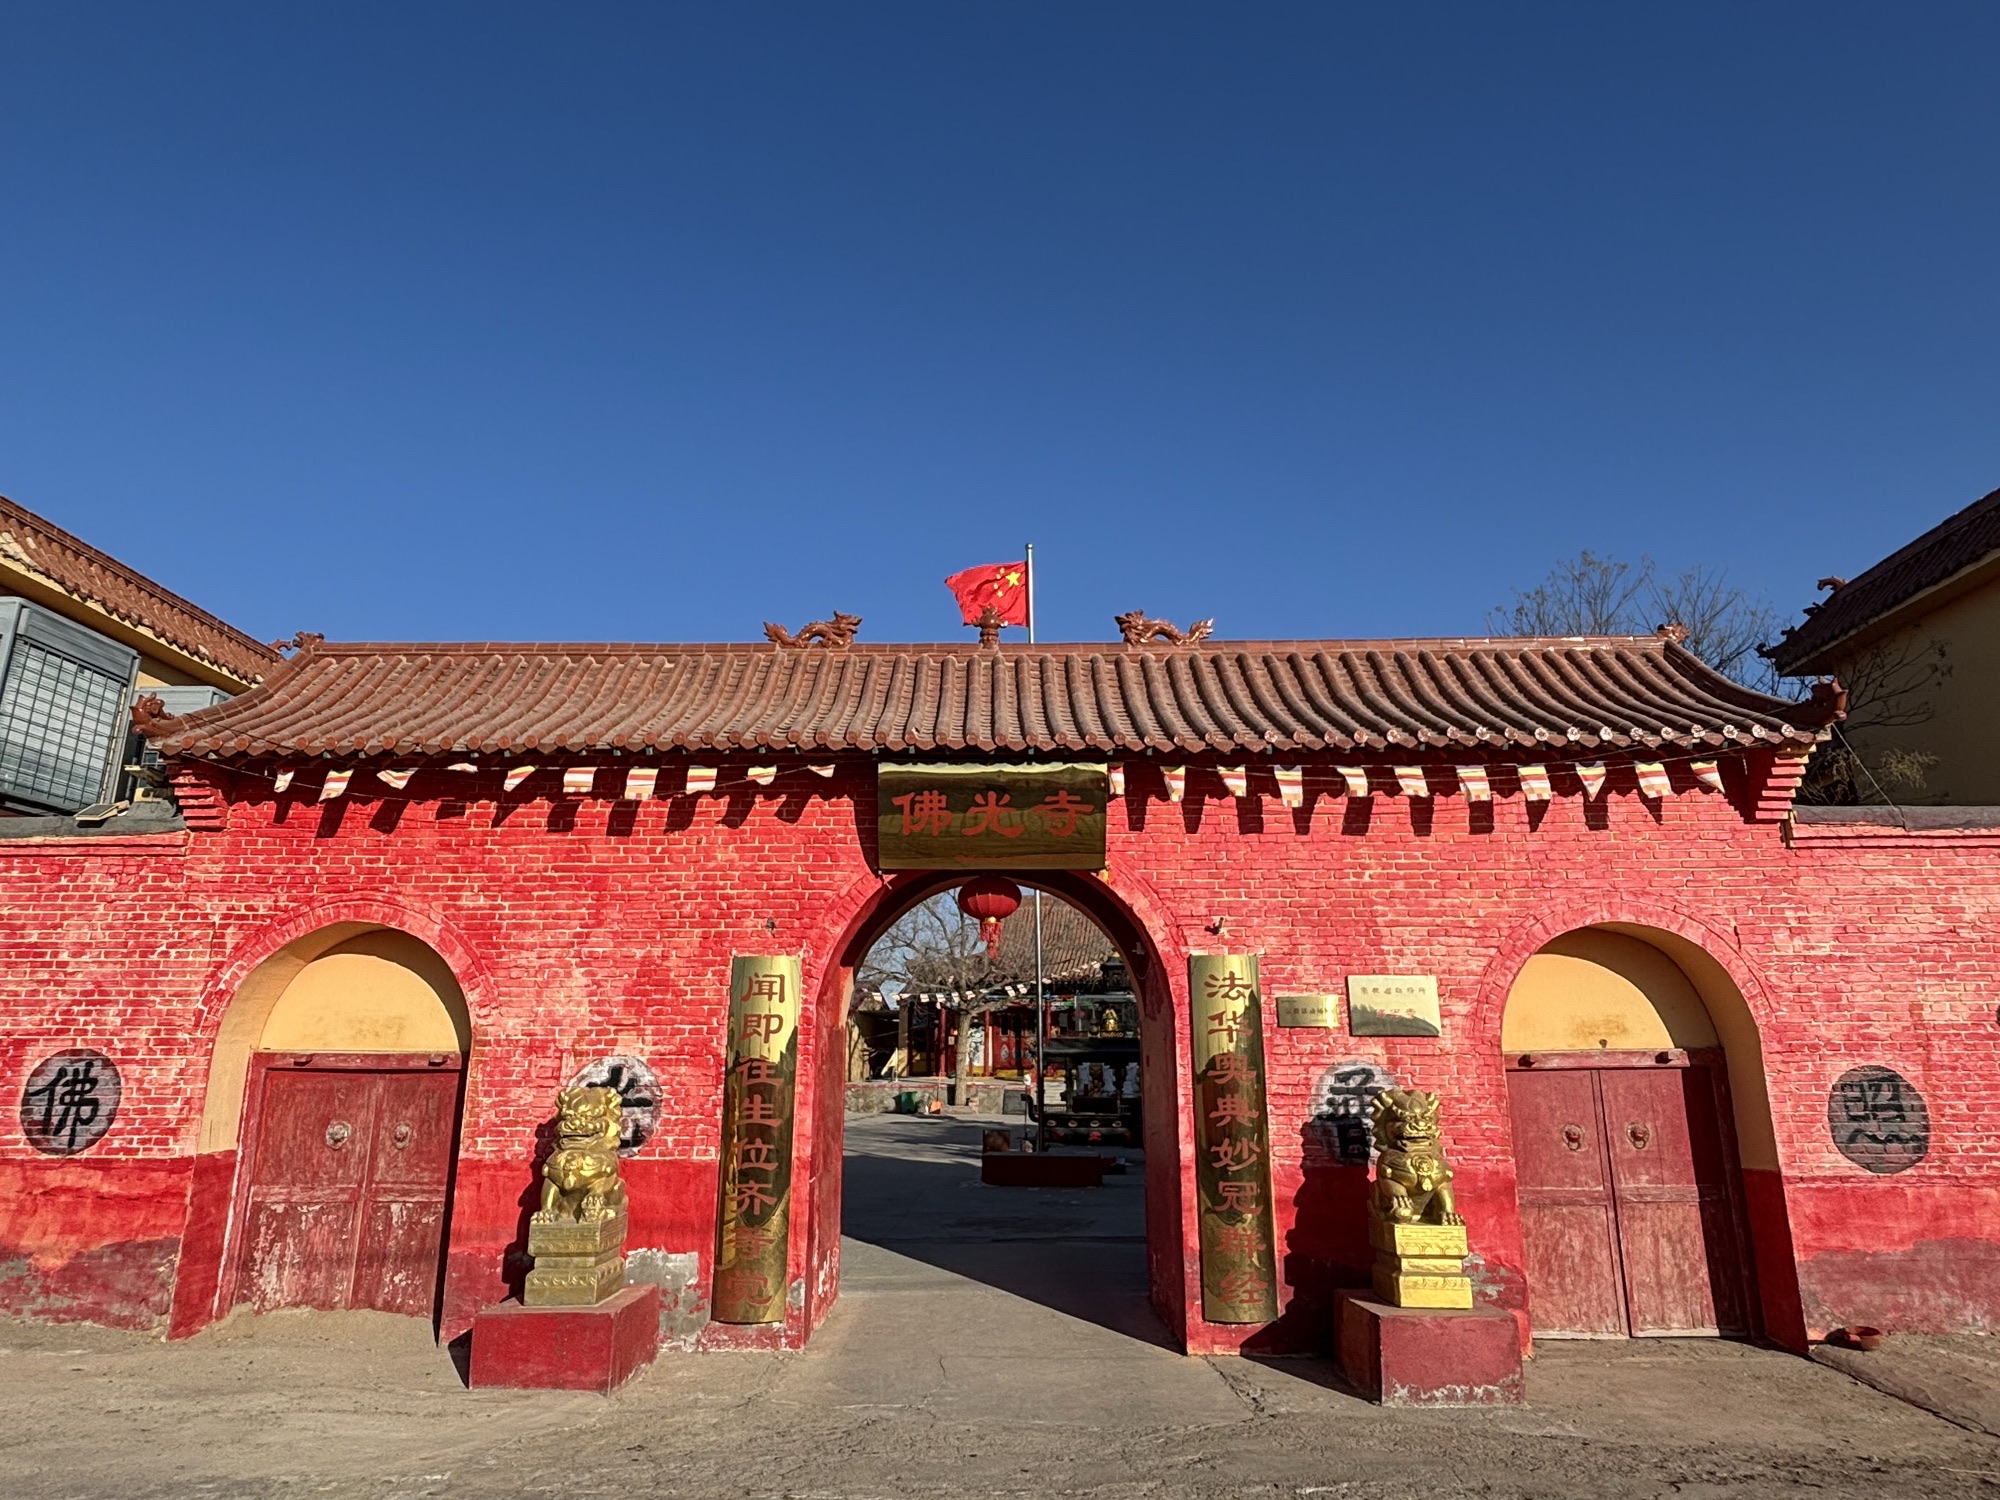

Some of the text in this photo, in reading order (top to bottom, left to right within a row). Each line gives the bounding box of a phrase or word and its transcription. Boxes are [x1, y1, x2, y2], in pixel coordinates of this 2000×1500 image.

[891, 789, 1096, 839] 佛光寺
[28, 1060, 100, 1149] 佛
[1203, 970, 1268, 1305] 法华奥典妙冠群经
